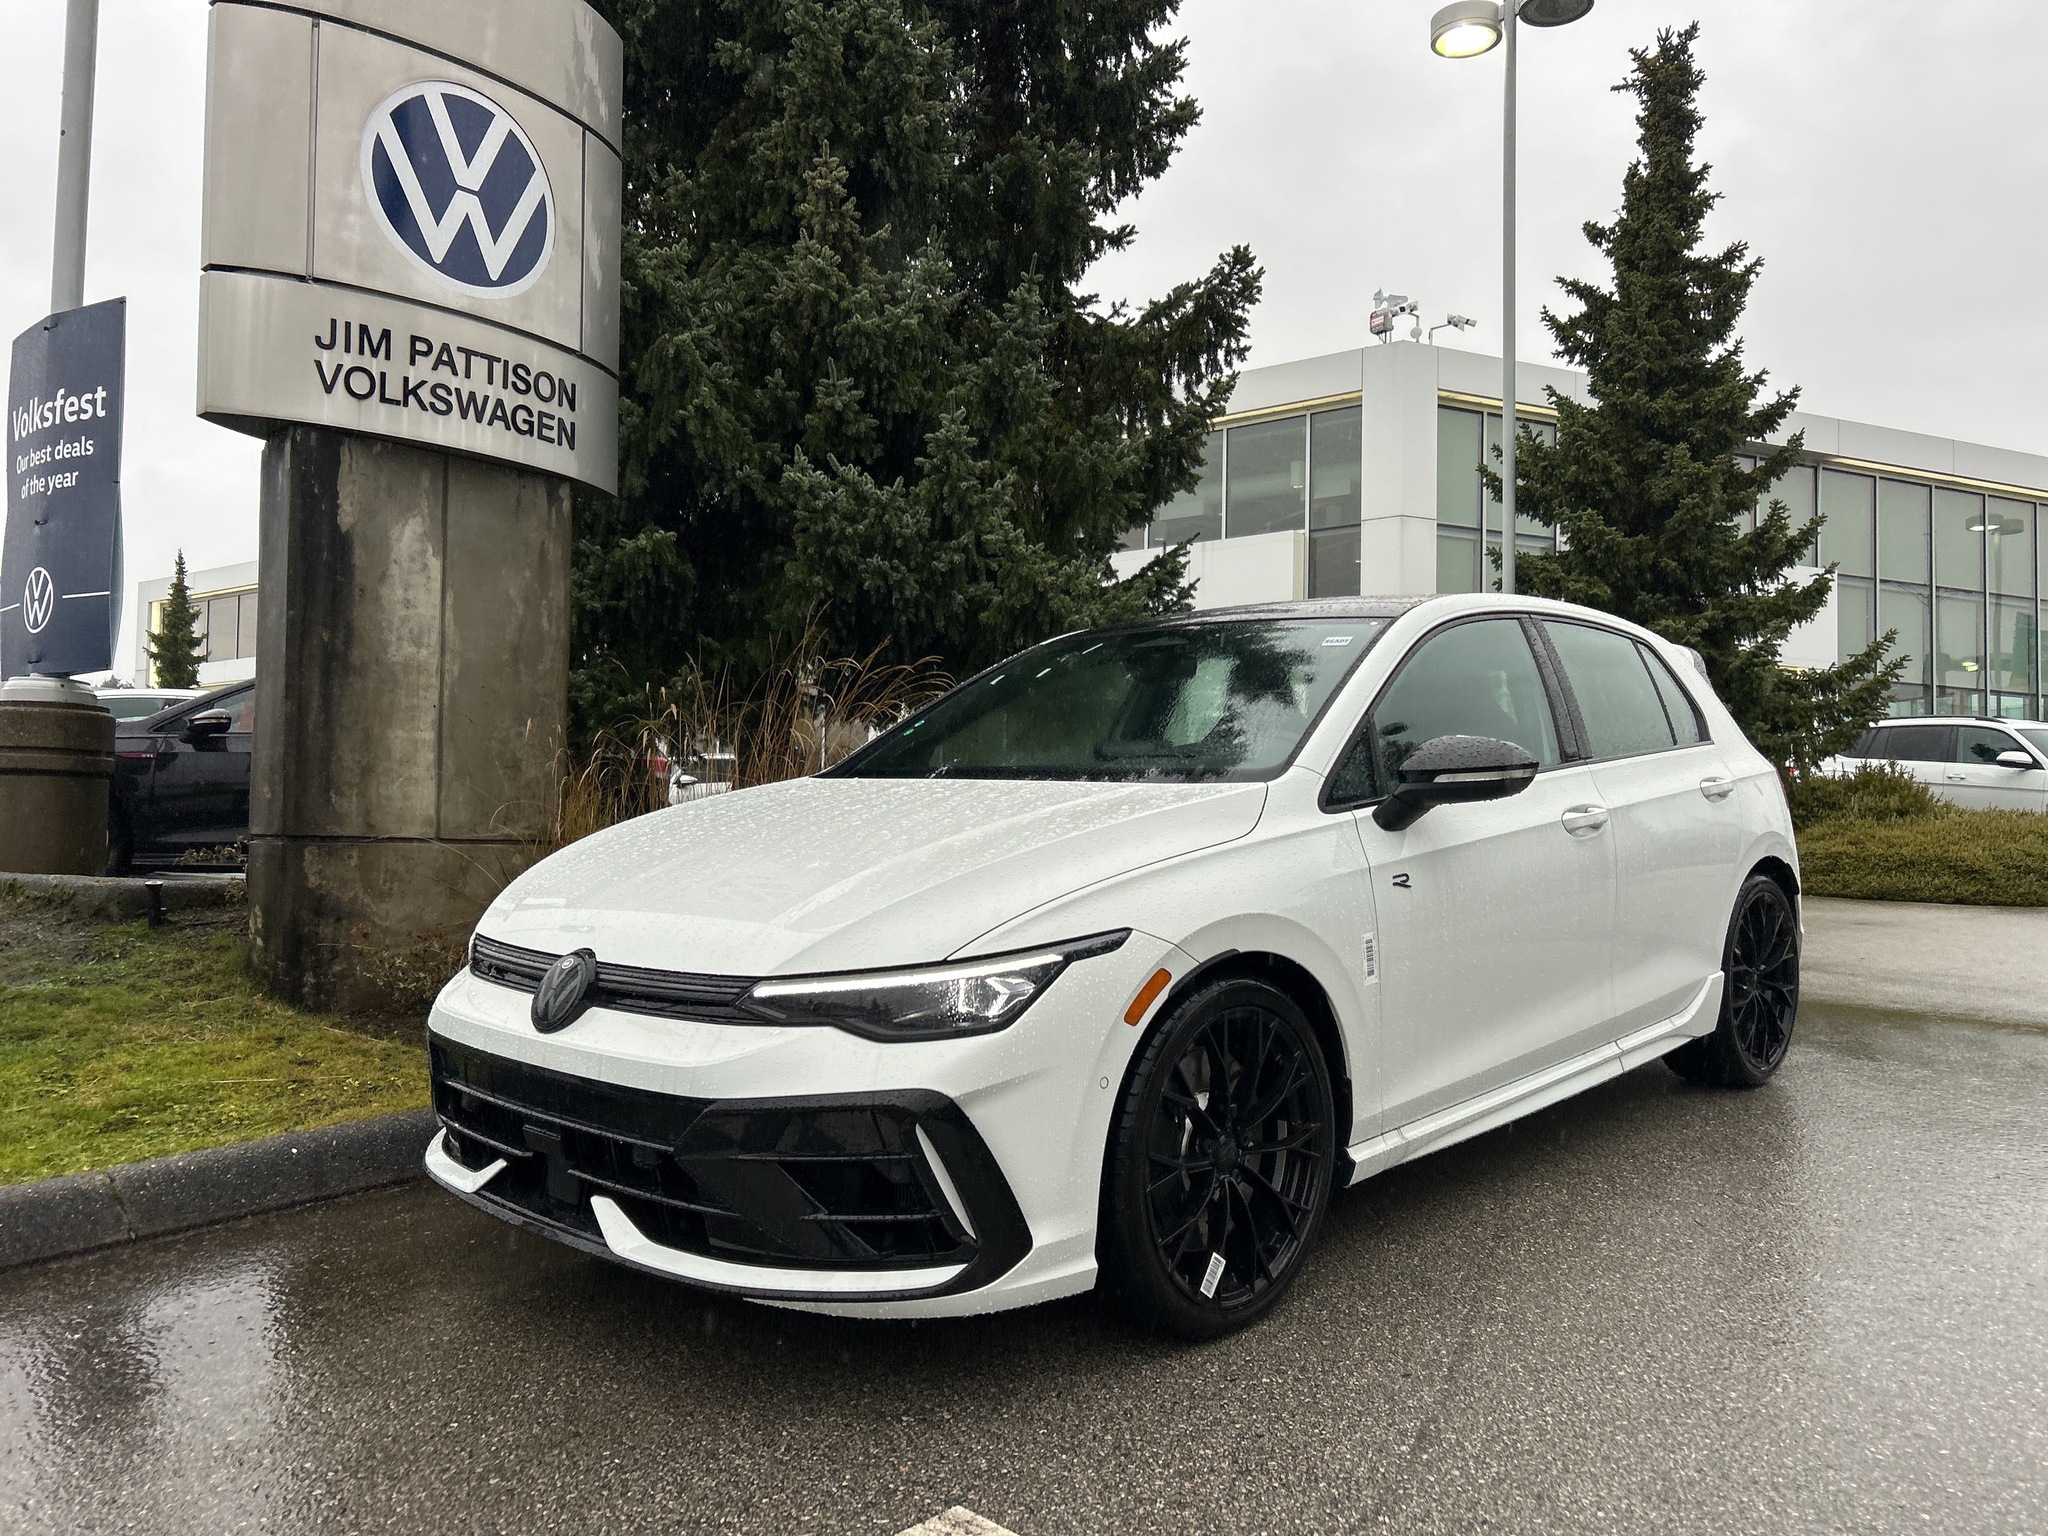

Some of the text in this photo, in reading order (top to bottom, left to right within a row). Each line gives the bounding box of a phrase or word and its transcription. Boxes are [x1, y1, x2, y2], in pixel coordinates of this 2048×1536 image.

[314, 317, 577, 412] JIM PATTISON
[12, 385, 107, 442] Volksfest
[313, 359, 576, 451] VOLKSWAGEN
[16, 435, 94, 475] Our best deals
[21, 470, 79, 500] of the year
[1392, 872, 1412, 889] R
